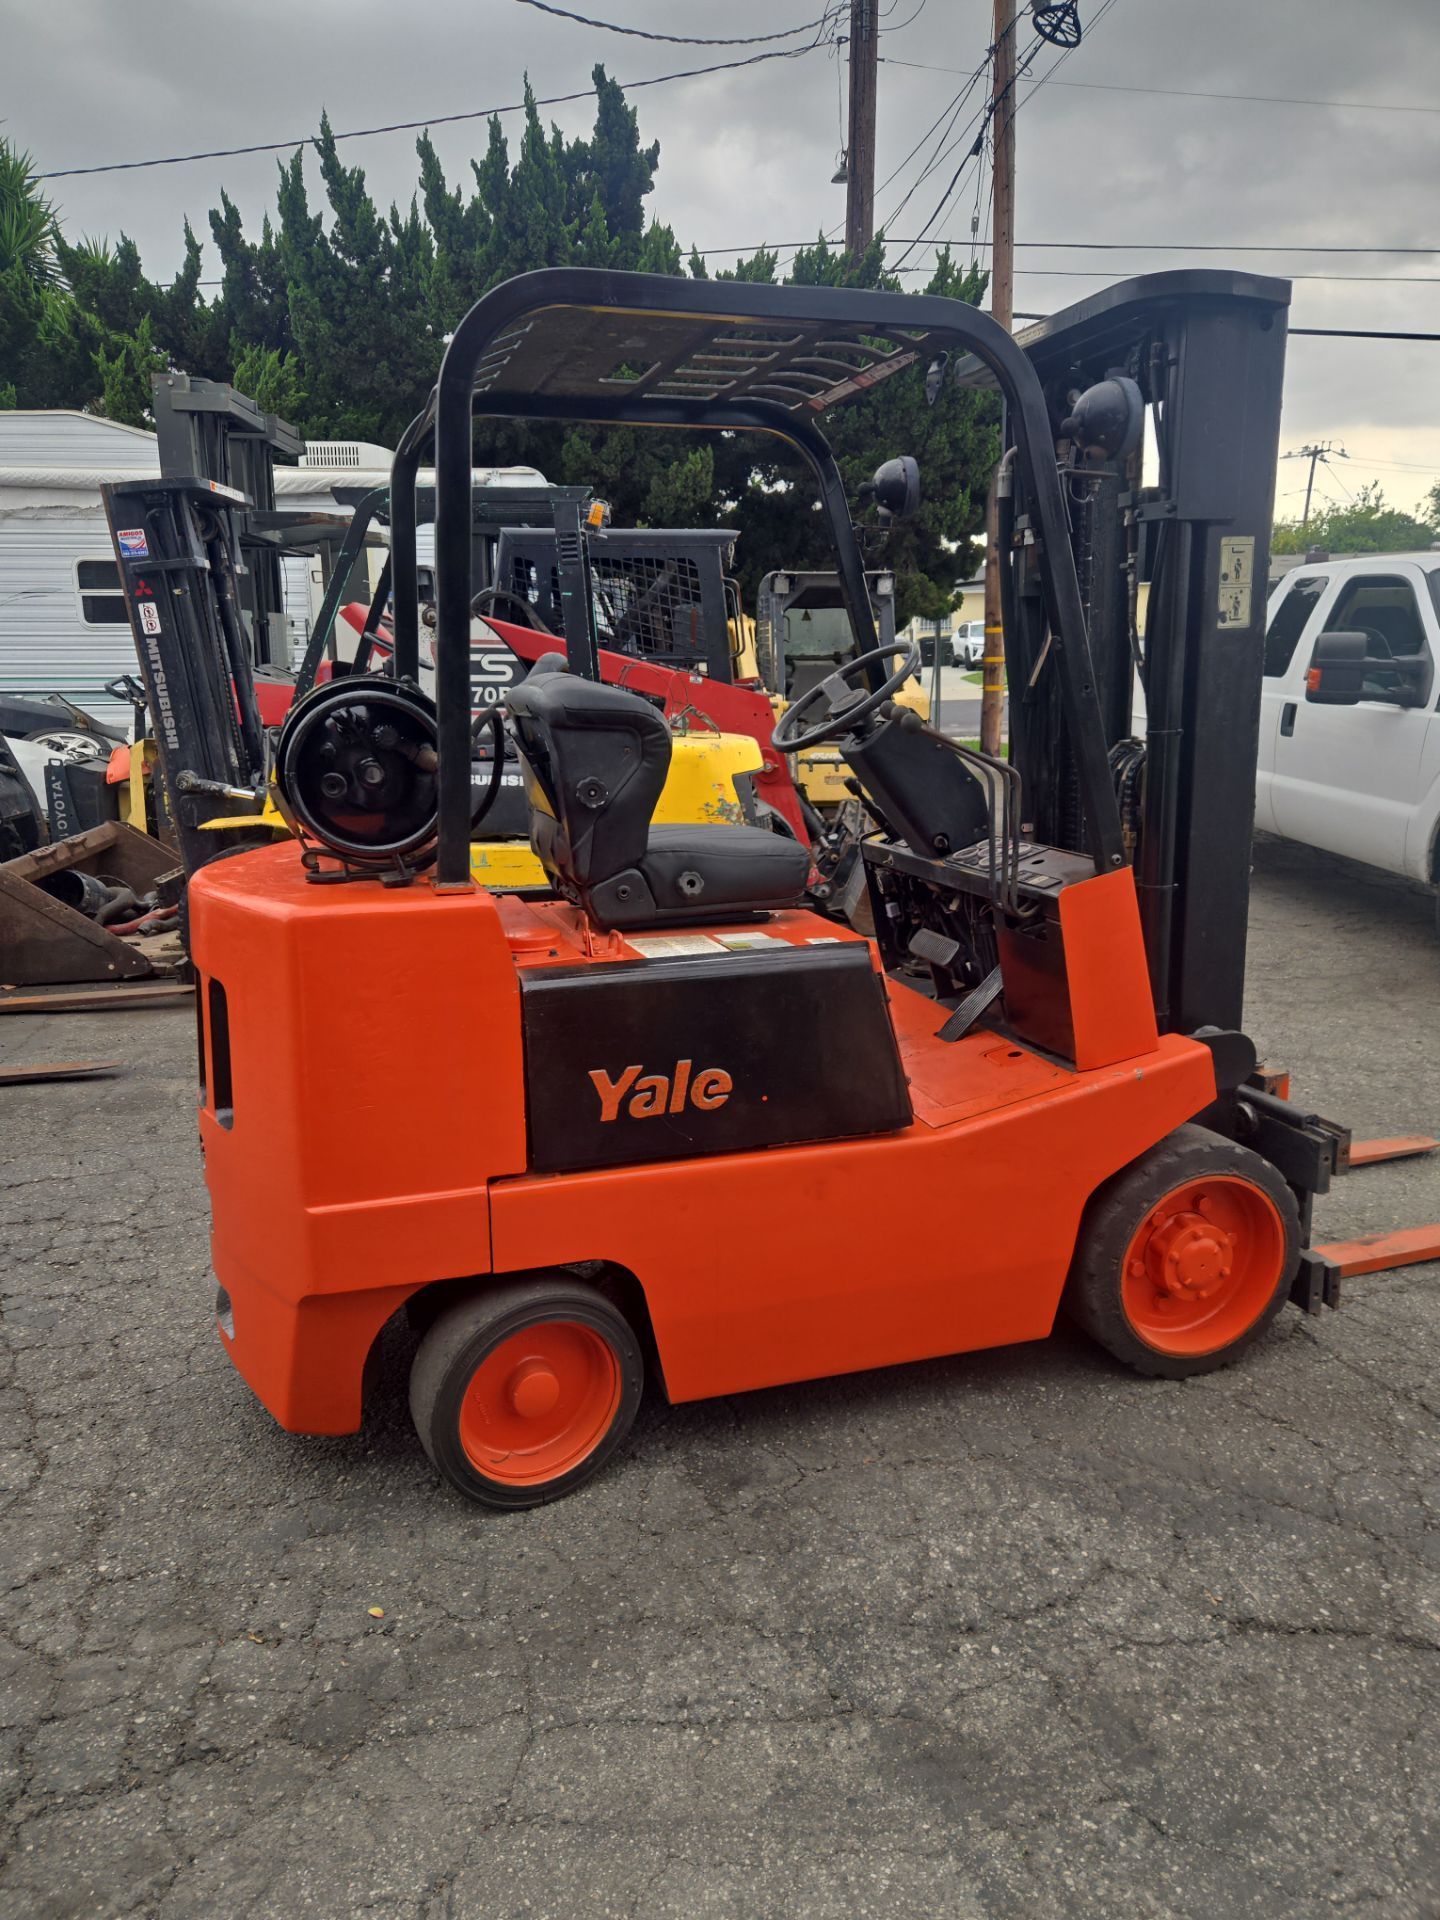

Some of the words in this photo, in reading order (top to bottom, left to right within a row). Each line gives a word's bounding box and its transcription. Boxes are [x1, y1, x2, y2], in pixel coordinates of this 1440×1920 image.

[146, 638, 179, 750] MITSUBISHI
[52, 780, 69, 837] OYOTA
[588, 1059, 733, 1121] Yale
